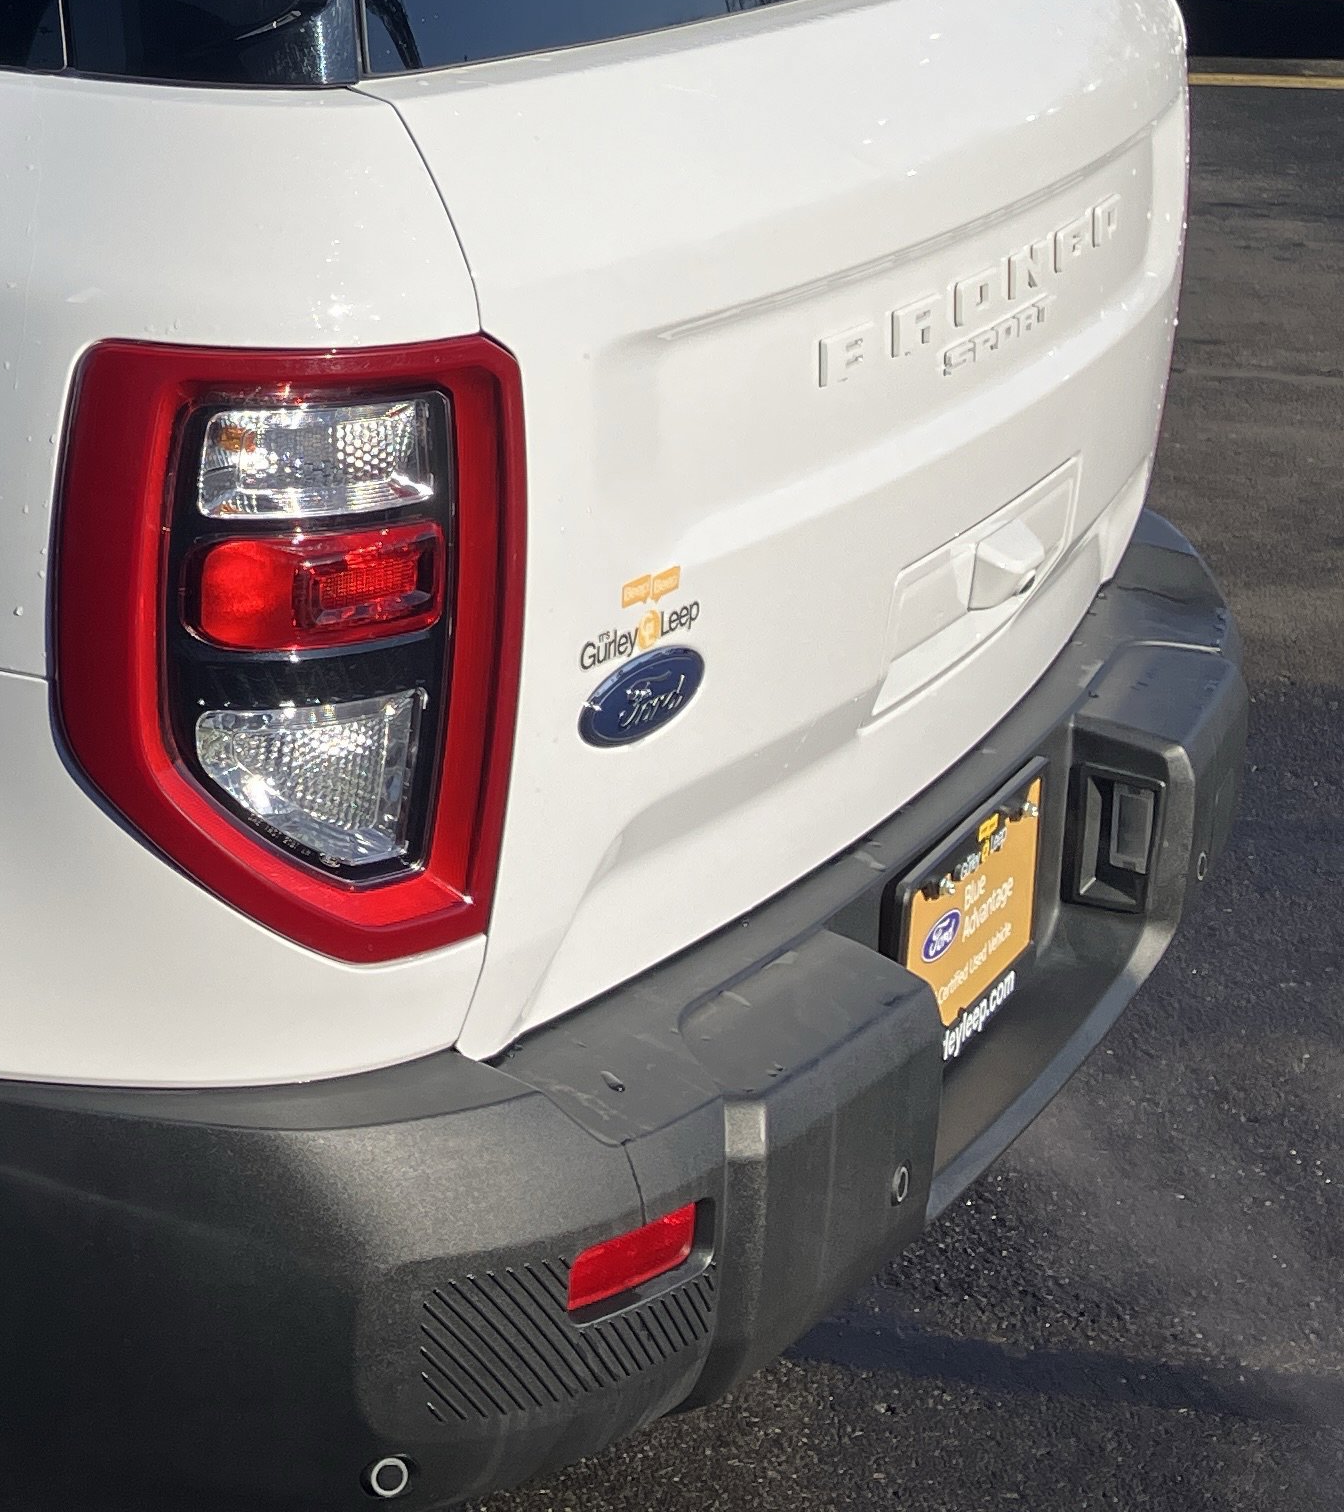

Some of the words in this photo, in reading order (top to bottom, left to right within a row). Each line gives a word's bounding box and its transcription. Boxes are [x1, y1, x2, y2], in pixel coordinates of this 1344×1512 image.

[942, 294, 1057, 376] SPORT
[580, 627, 639, 670] Gurley
[661, 600, 700, 637] Leep
[618, 670, 686, 730] Ford
[962, 877, 1014, 942] Advantage
[963, 875, 986, 911] Blue
[929, 919, 955, 957] Ford
